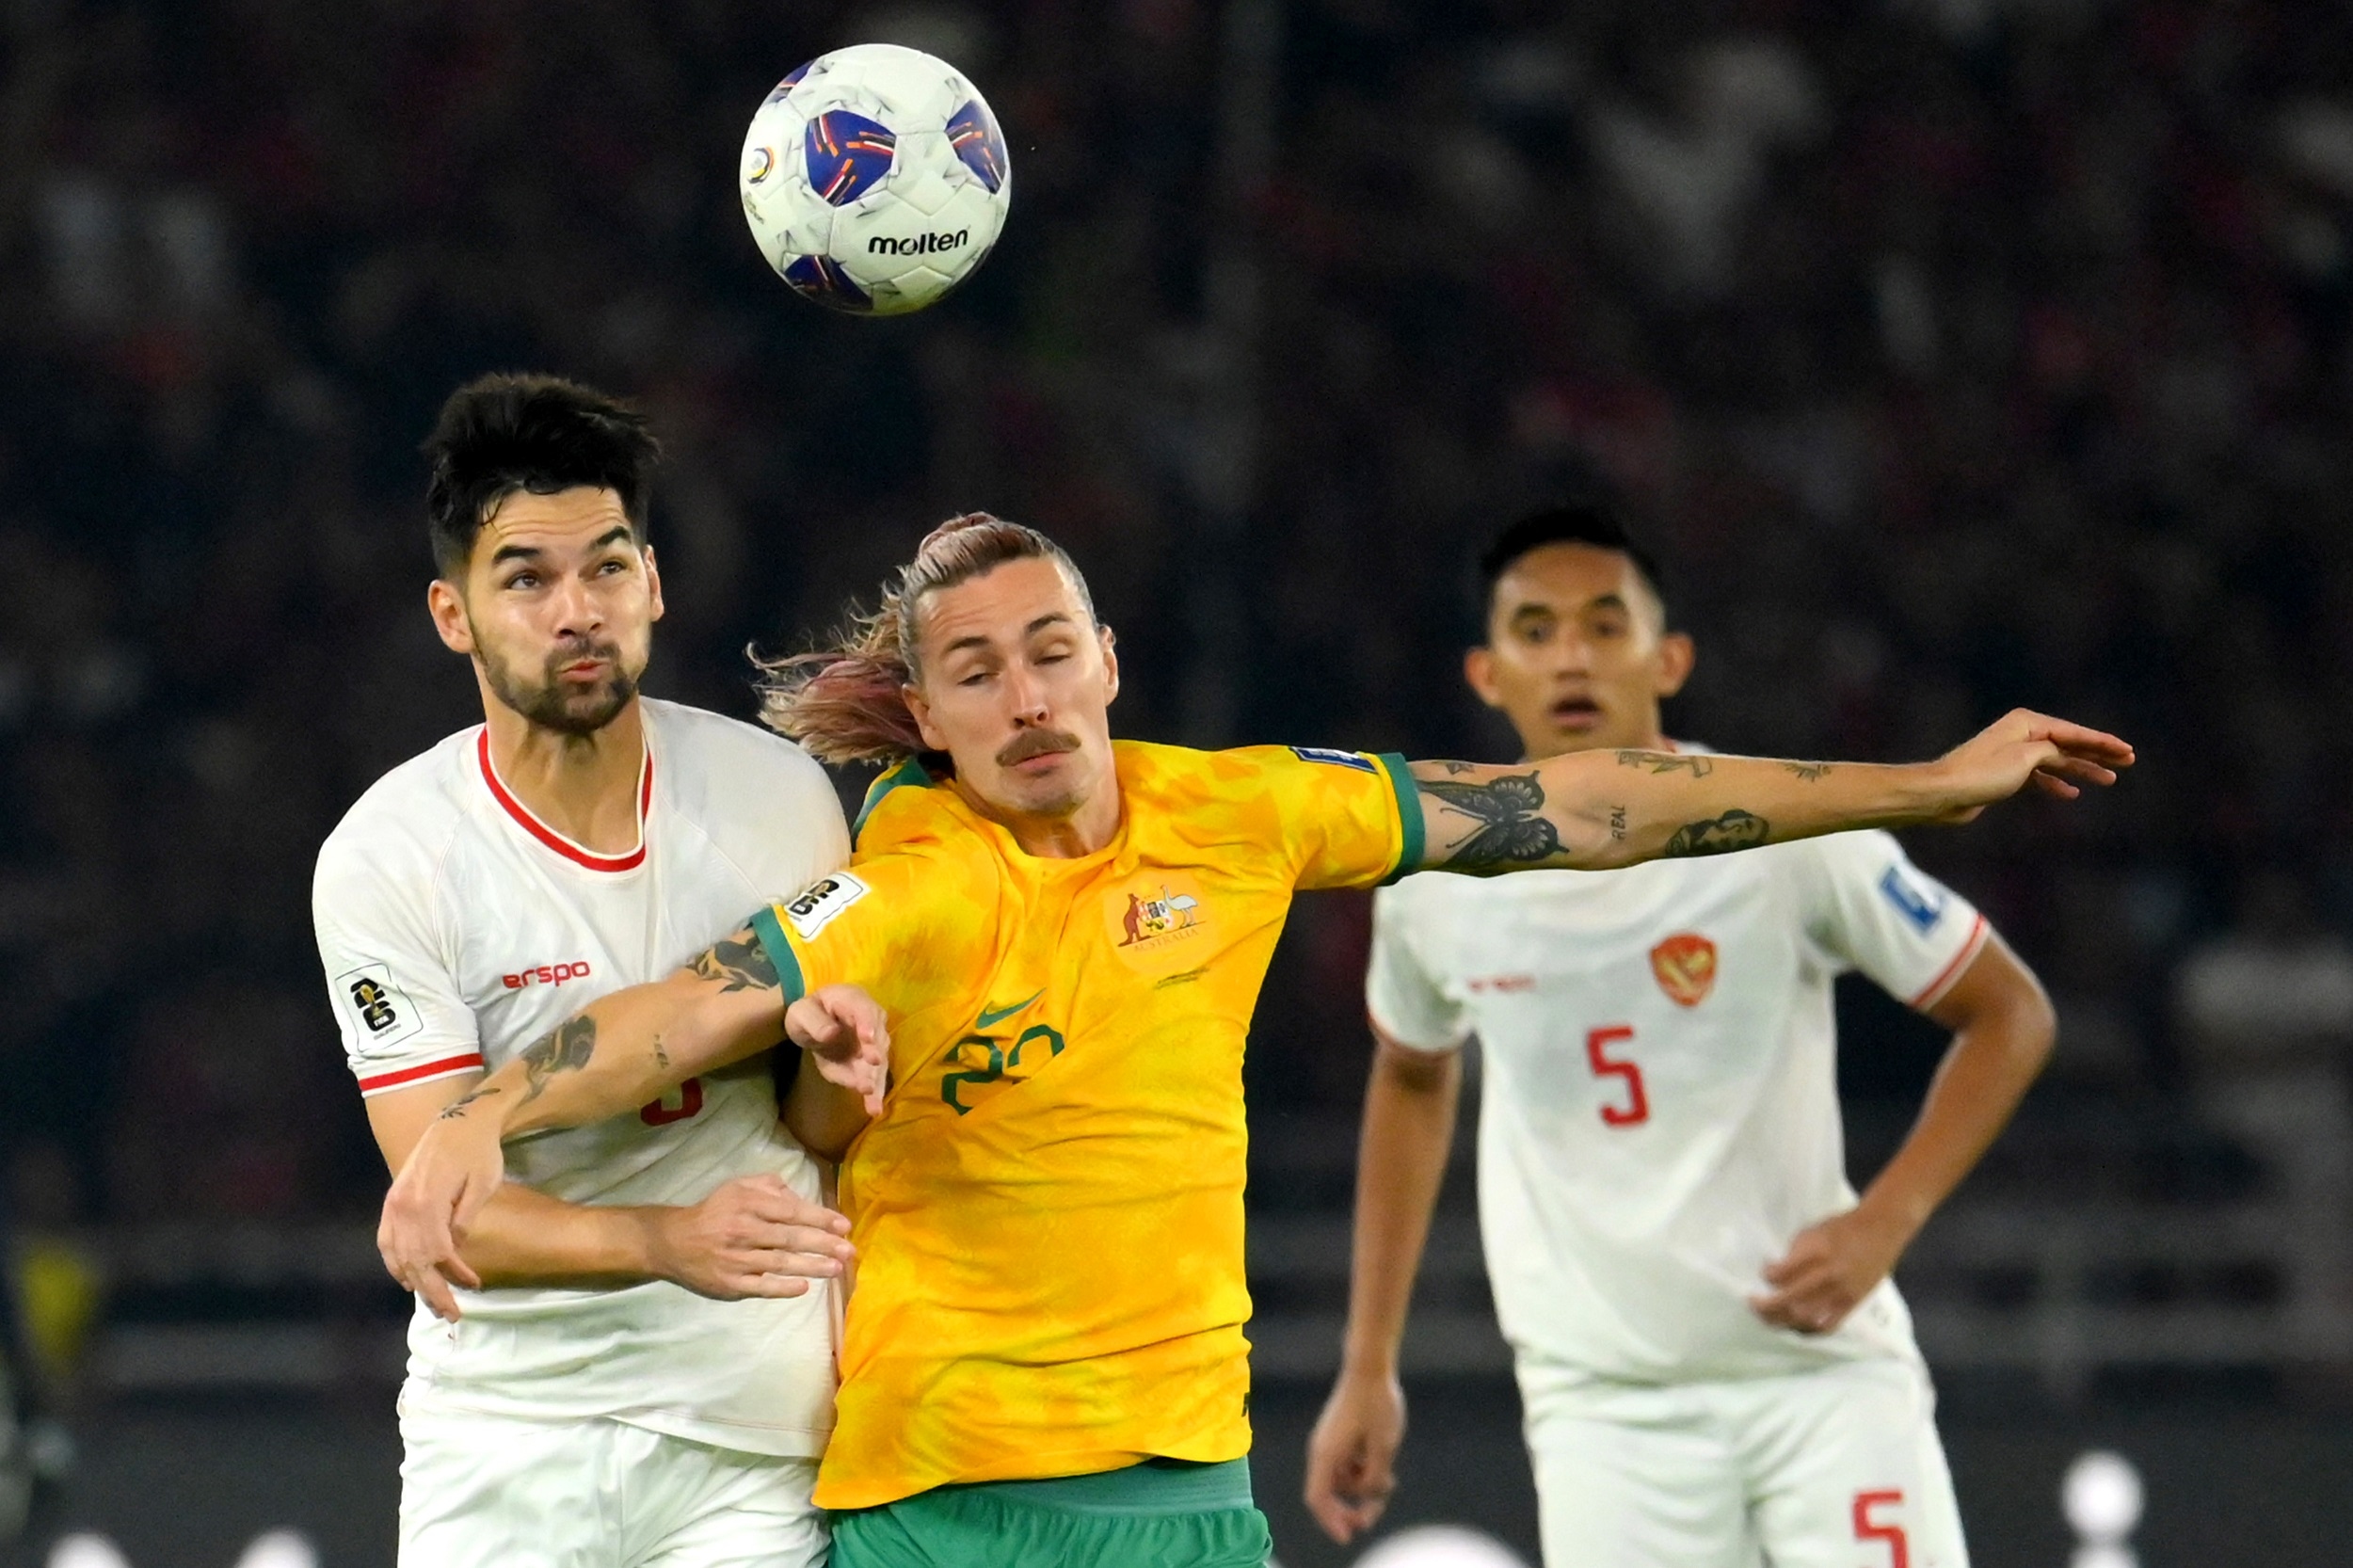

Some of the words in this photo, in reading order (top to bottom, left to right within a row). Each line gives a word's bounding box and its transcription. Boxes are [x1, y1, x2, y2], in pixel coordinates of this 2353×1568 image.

[868, 229, 968, 256] molten
[1610, 804, 1626, 840] REAL
[502, 961, 591, 988] erspo
[1586, 1026, 1648, 1126] 5
[1852, 1491, 1910, 1568] 5
